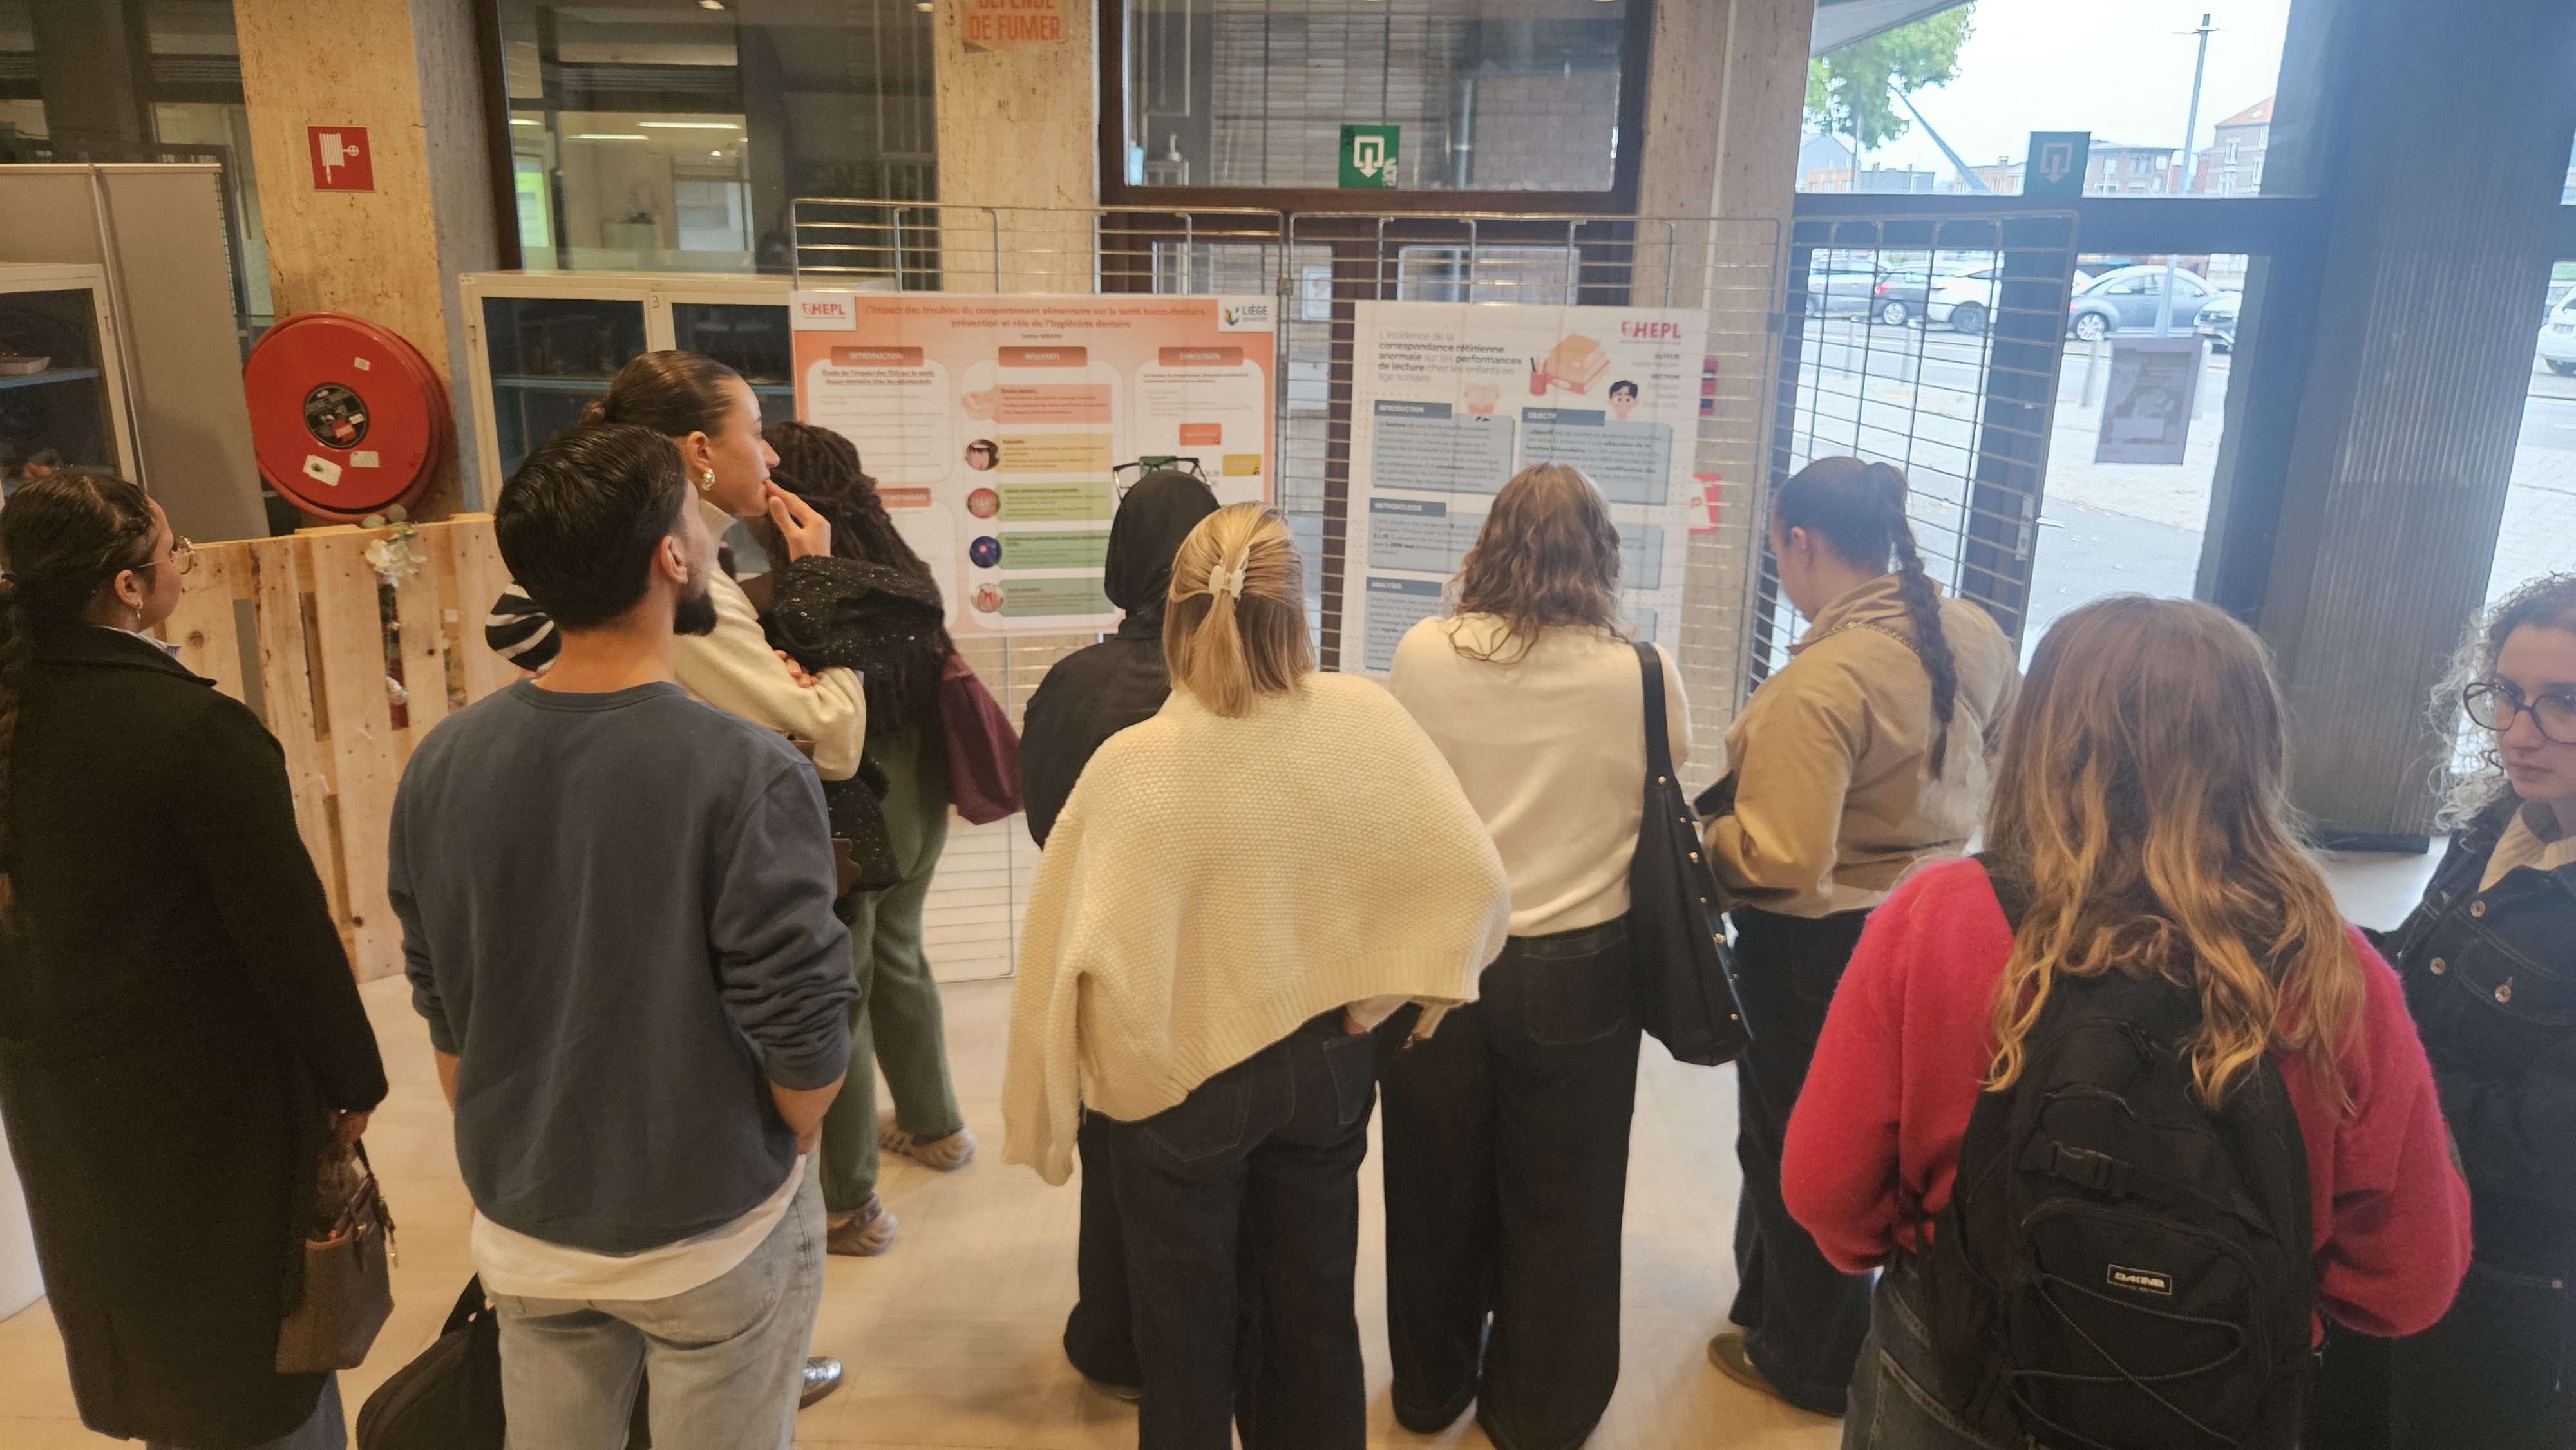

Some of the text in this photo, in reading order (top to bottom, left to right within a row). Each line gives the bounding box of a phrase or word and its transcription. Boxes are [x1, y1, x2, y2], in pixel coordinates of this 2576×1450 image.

[969, 15, 1061, 41] DE FUMER
[810, 303, 846, 315] HEPL
[866, 305, 902, 316] L'impact
[905, 306, 922, 314] des
[923, 306, 956, 315] troubles
[961, 306, 974, 315] du
[975, 307, 1041, 317] comportement
[1042, 307, 1092, 315] alimentaire
[1108, 307, 1117, 315] la
[1143, 308, 1205, 316] bucco-dentaire
[1242, 305, 1269, 315] LIÈGE
[951, 319, 998, 330] prévention
[1013, 319, 1029, 328] rôle
[1031, 320, 1043, 328] de
[1045, 320, 1094, 330] l'hygiéniste
[1095, 320, 1132, 328] dentaire
[1379, 330, 1454, 342] L'incidence de la
[1633, 322, 1681, 339] HEPL
[1379, 343, 1504, 353] correspondance rétinienne
[849, 352, 904, 360] INTRODUCTION
[1024, 352, 1061, 361] RÉSULTATS
[1378, 352, 1422, 362] anormale
[1439, 353, 1454, 362] les
[1455, 355, 1522, 366] performances
[1378, 362, 1390, 370] de
[1391, 363, 1425, 372] lecture
[1426, 364, 1448, 373] chez
[1450, 364, 1463, 373] les
[1465, 366, 1501, 375] enfants
[1377, 372, 1394, 384] âge
[1378, 404, 1425, 413] INTRODUCTION
[1527, 411, 1558, 420] OBJECTIF
[1370, 581, 1403, 590] ANALYSES
